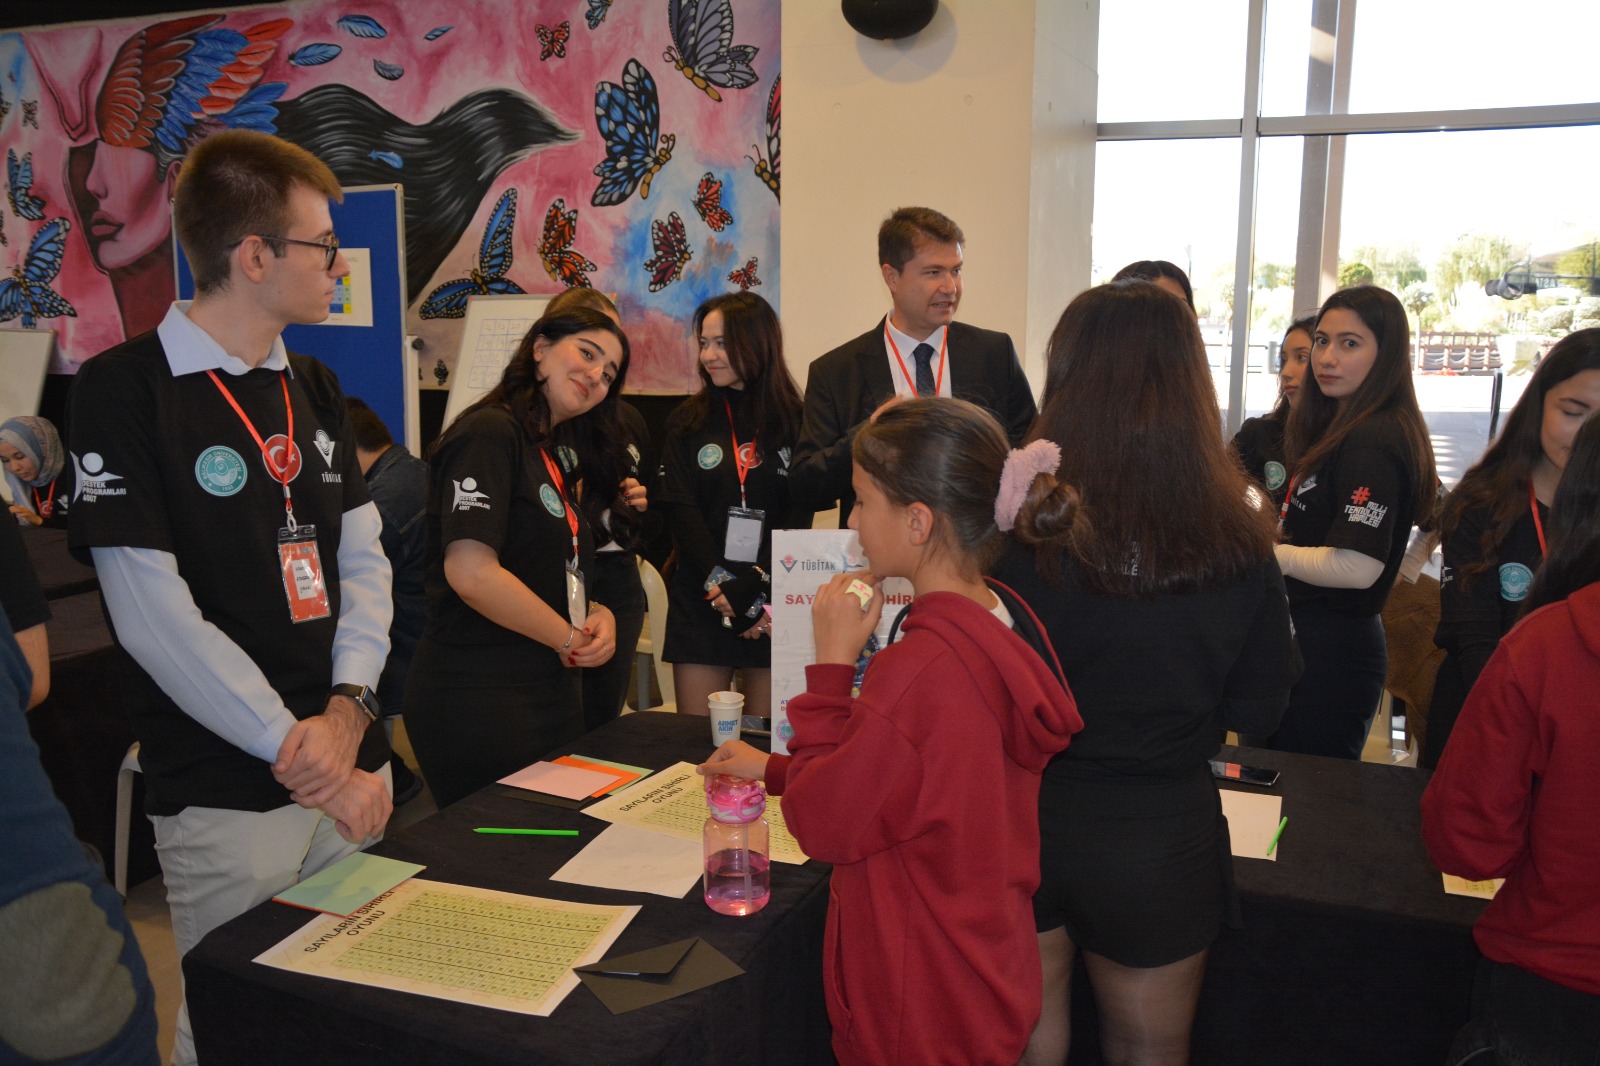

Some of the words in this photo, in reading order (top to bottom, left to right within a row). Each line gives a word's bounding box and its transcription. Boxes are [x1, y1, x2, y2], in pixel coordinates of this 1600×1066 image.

[801, 560, 836, 571] TÜBİTAK
[785, 594, 815, 605] SAY
[620, 788, 664, 812] SAYILARIN
[652, 787, 683, 804] OYUNU
[304, 914, 362, 953] SAYILARIN
[346, 910, 386, 937] OYUNU
